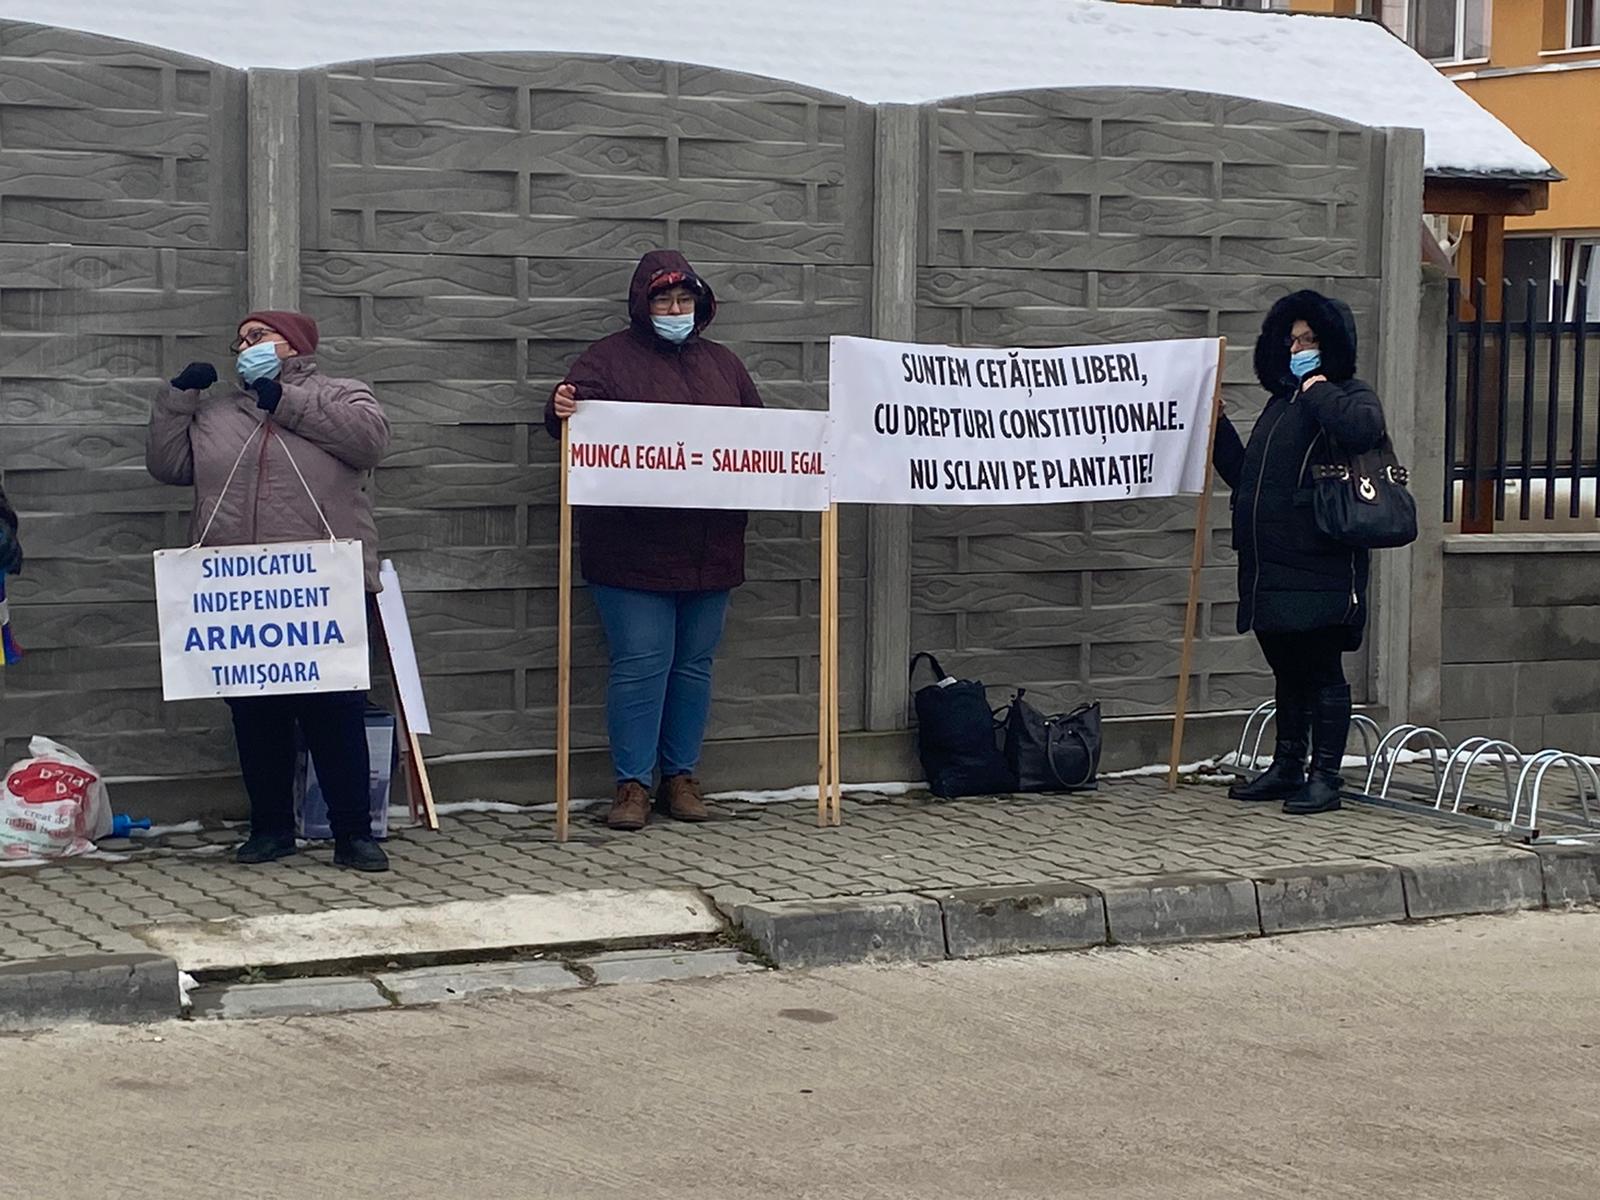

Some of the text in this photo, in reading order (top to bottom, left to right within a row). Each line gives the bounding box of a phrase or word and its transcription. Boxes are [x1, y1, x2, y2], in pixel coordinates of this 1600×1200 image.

[901, 351, 1148, 397] SUNTEM CETĂȚENI LIBERI,
[874, 401, 1185, 444] CU DREPTURI CONSTITUȚIONALE.
[571, 443, 631, 469] MUNCA
[635, 441, 687, 470] EGALĂ
[712, 448, 787, 474] SALARIUL
[791, 451, 826, 475] EGAL
[910, 453, 1154, 494] NU SCLAVI PE PLANTAȚIE!
[202, 553, 317, 578] SINDICATUL
[193, 587, 330, 613] INDEPENDENT
[184, 620, 345, 651] ARMONIA
[212, 661, 320, 690] TIMIȘOARA
